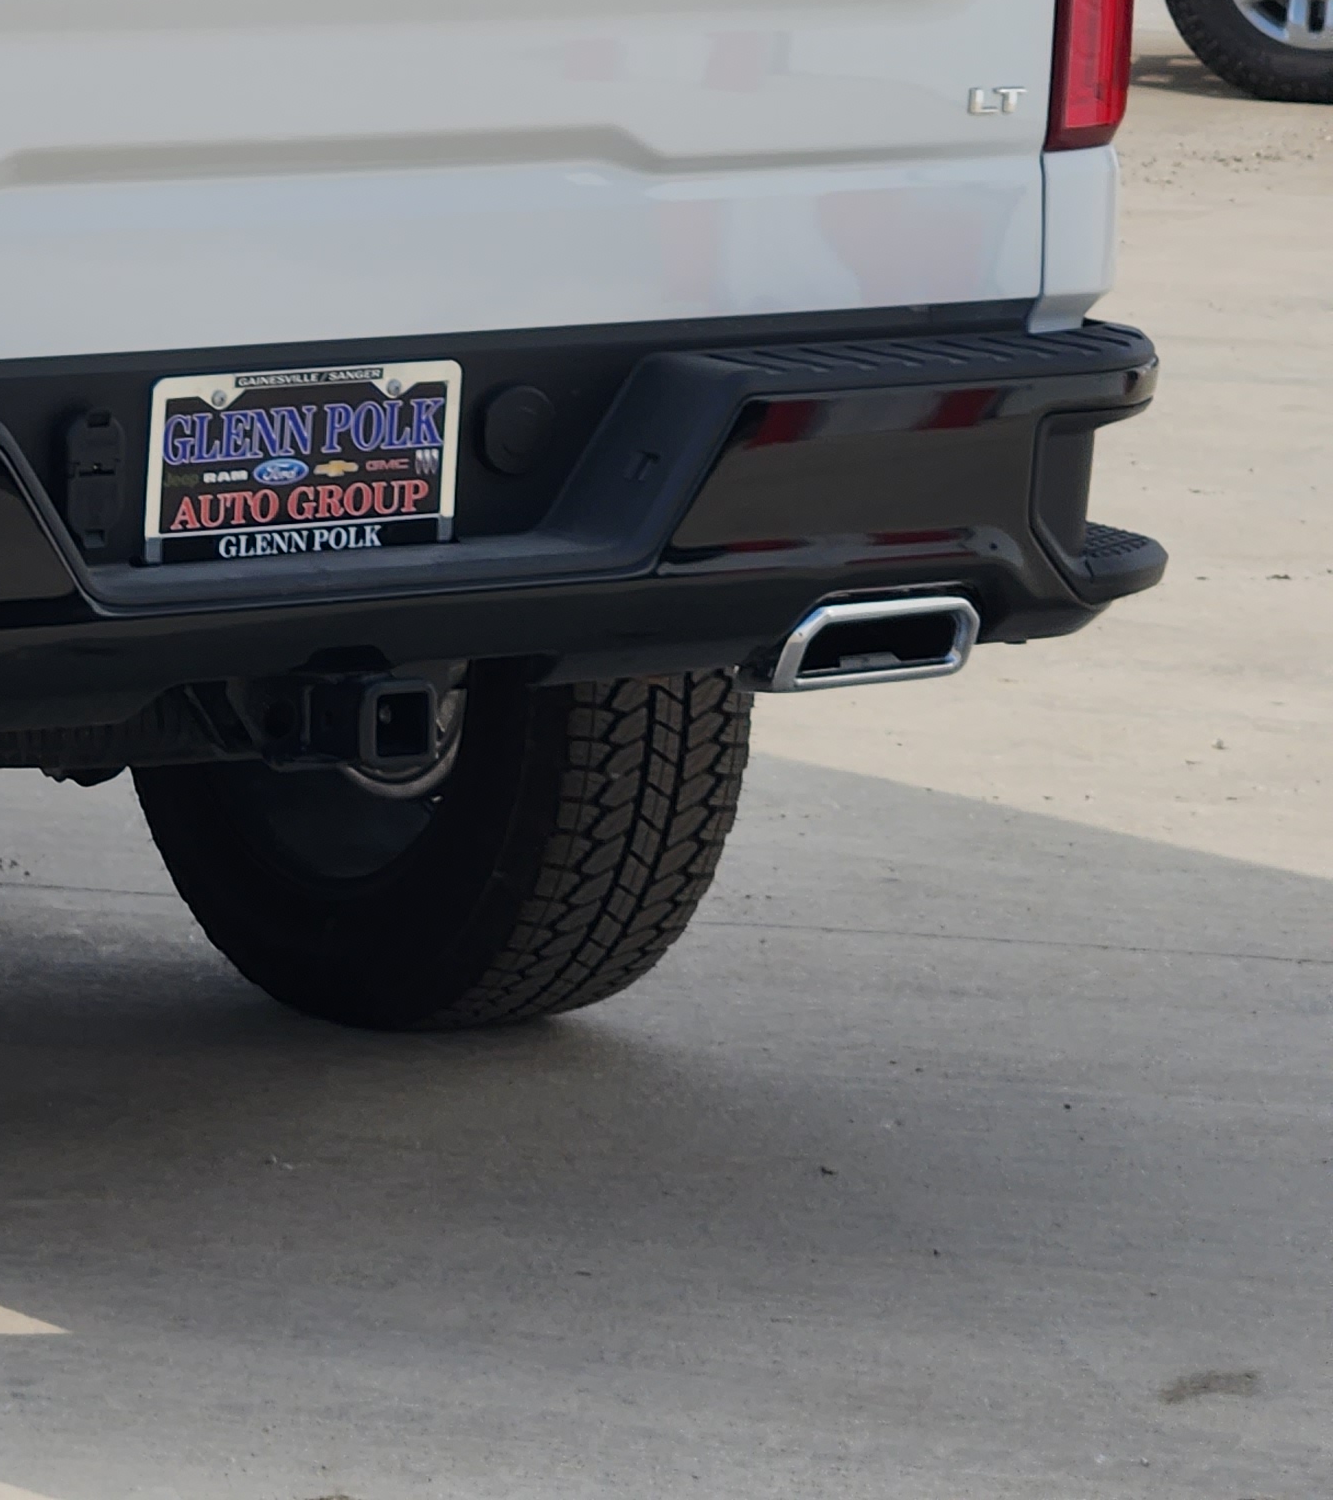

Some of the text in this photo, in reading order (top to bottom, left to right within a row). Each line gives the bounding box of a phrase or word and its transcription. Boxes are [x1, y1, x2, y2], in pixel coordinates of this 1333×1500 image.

[966, 86, 1027, 115] LT
[163, 397, 445, 465] GLENN POLK
[203, 469, 248, 483] RAM
[258, 459, 302, 483] Ford
[365, 458, 411, 472] GMC
[170, 479, 429, 531] AUTO GROUP
[219, 525, 383, 559] GLENN POLK
